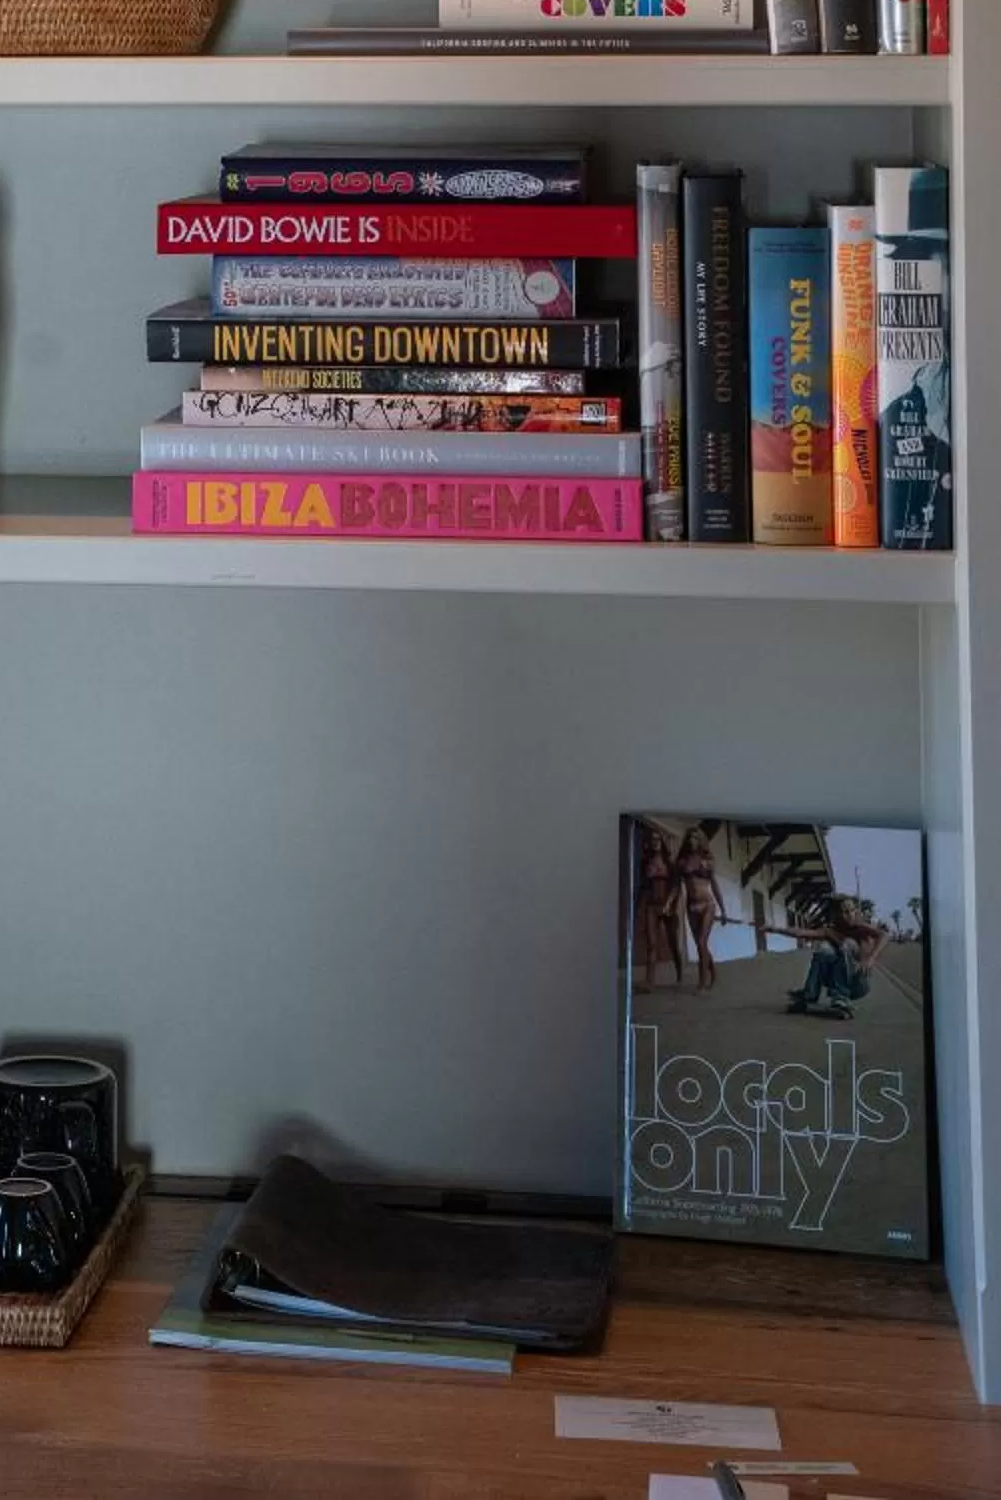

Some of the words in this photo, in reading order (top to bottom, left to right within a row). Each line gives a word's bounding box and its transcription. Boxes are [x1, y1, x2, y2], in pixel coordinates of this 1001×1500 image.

[245, 171, 415, 194] 1965
[167, 215, 255, 243] DAVID
[259, 215, 352, 243] BOWIE
[358, 215, 380, 243] IS
[386, 215, 475, 244] INSIDE
[696, 262, 706, 279] MY
[710, 206, 732, 312] FREEDOM
[894, 261, 922, 291] BILL
[838, 242, 859, 348] SUNSHINE
[856, 242, 874, 338] ORANGE
[879, 295, 940, 326] GRAHAM
[214, 325, 365, 362] INVENTING
[373, 326, 549, 364] DOWNTOWN
[789, 278, 812, 366] FUNK
[312, 369, 363, 389] SOCIETIES
[713, 320, 733, 404] FOUND
[772, 336, 788, 425] COVERS
[790, 373, 812, 397] &
[379, 446, 441, 463] BOOK
[790, 404, 812, 485] SOUL
[186, 481, 336, 528] IBIZA
[341, 482, 607, 534] BOHEMIA
[630, 1023, 911, 1144] locals
[630, 1101, 857, 1231] only
